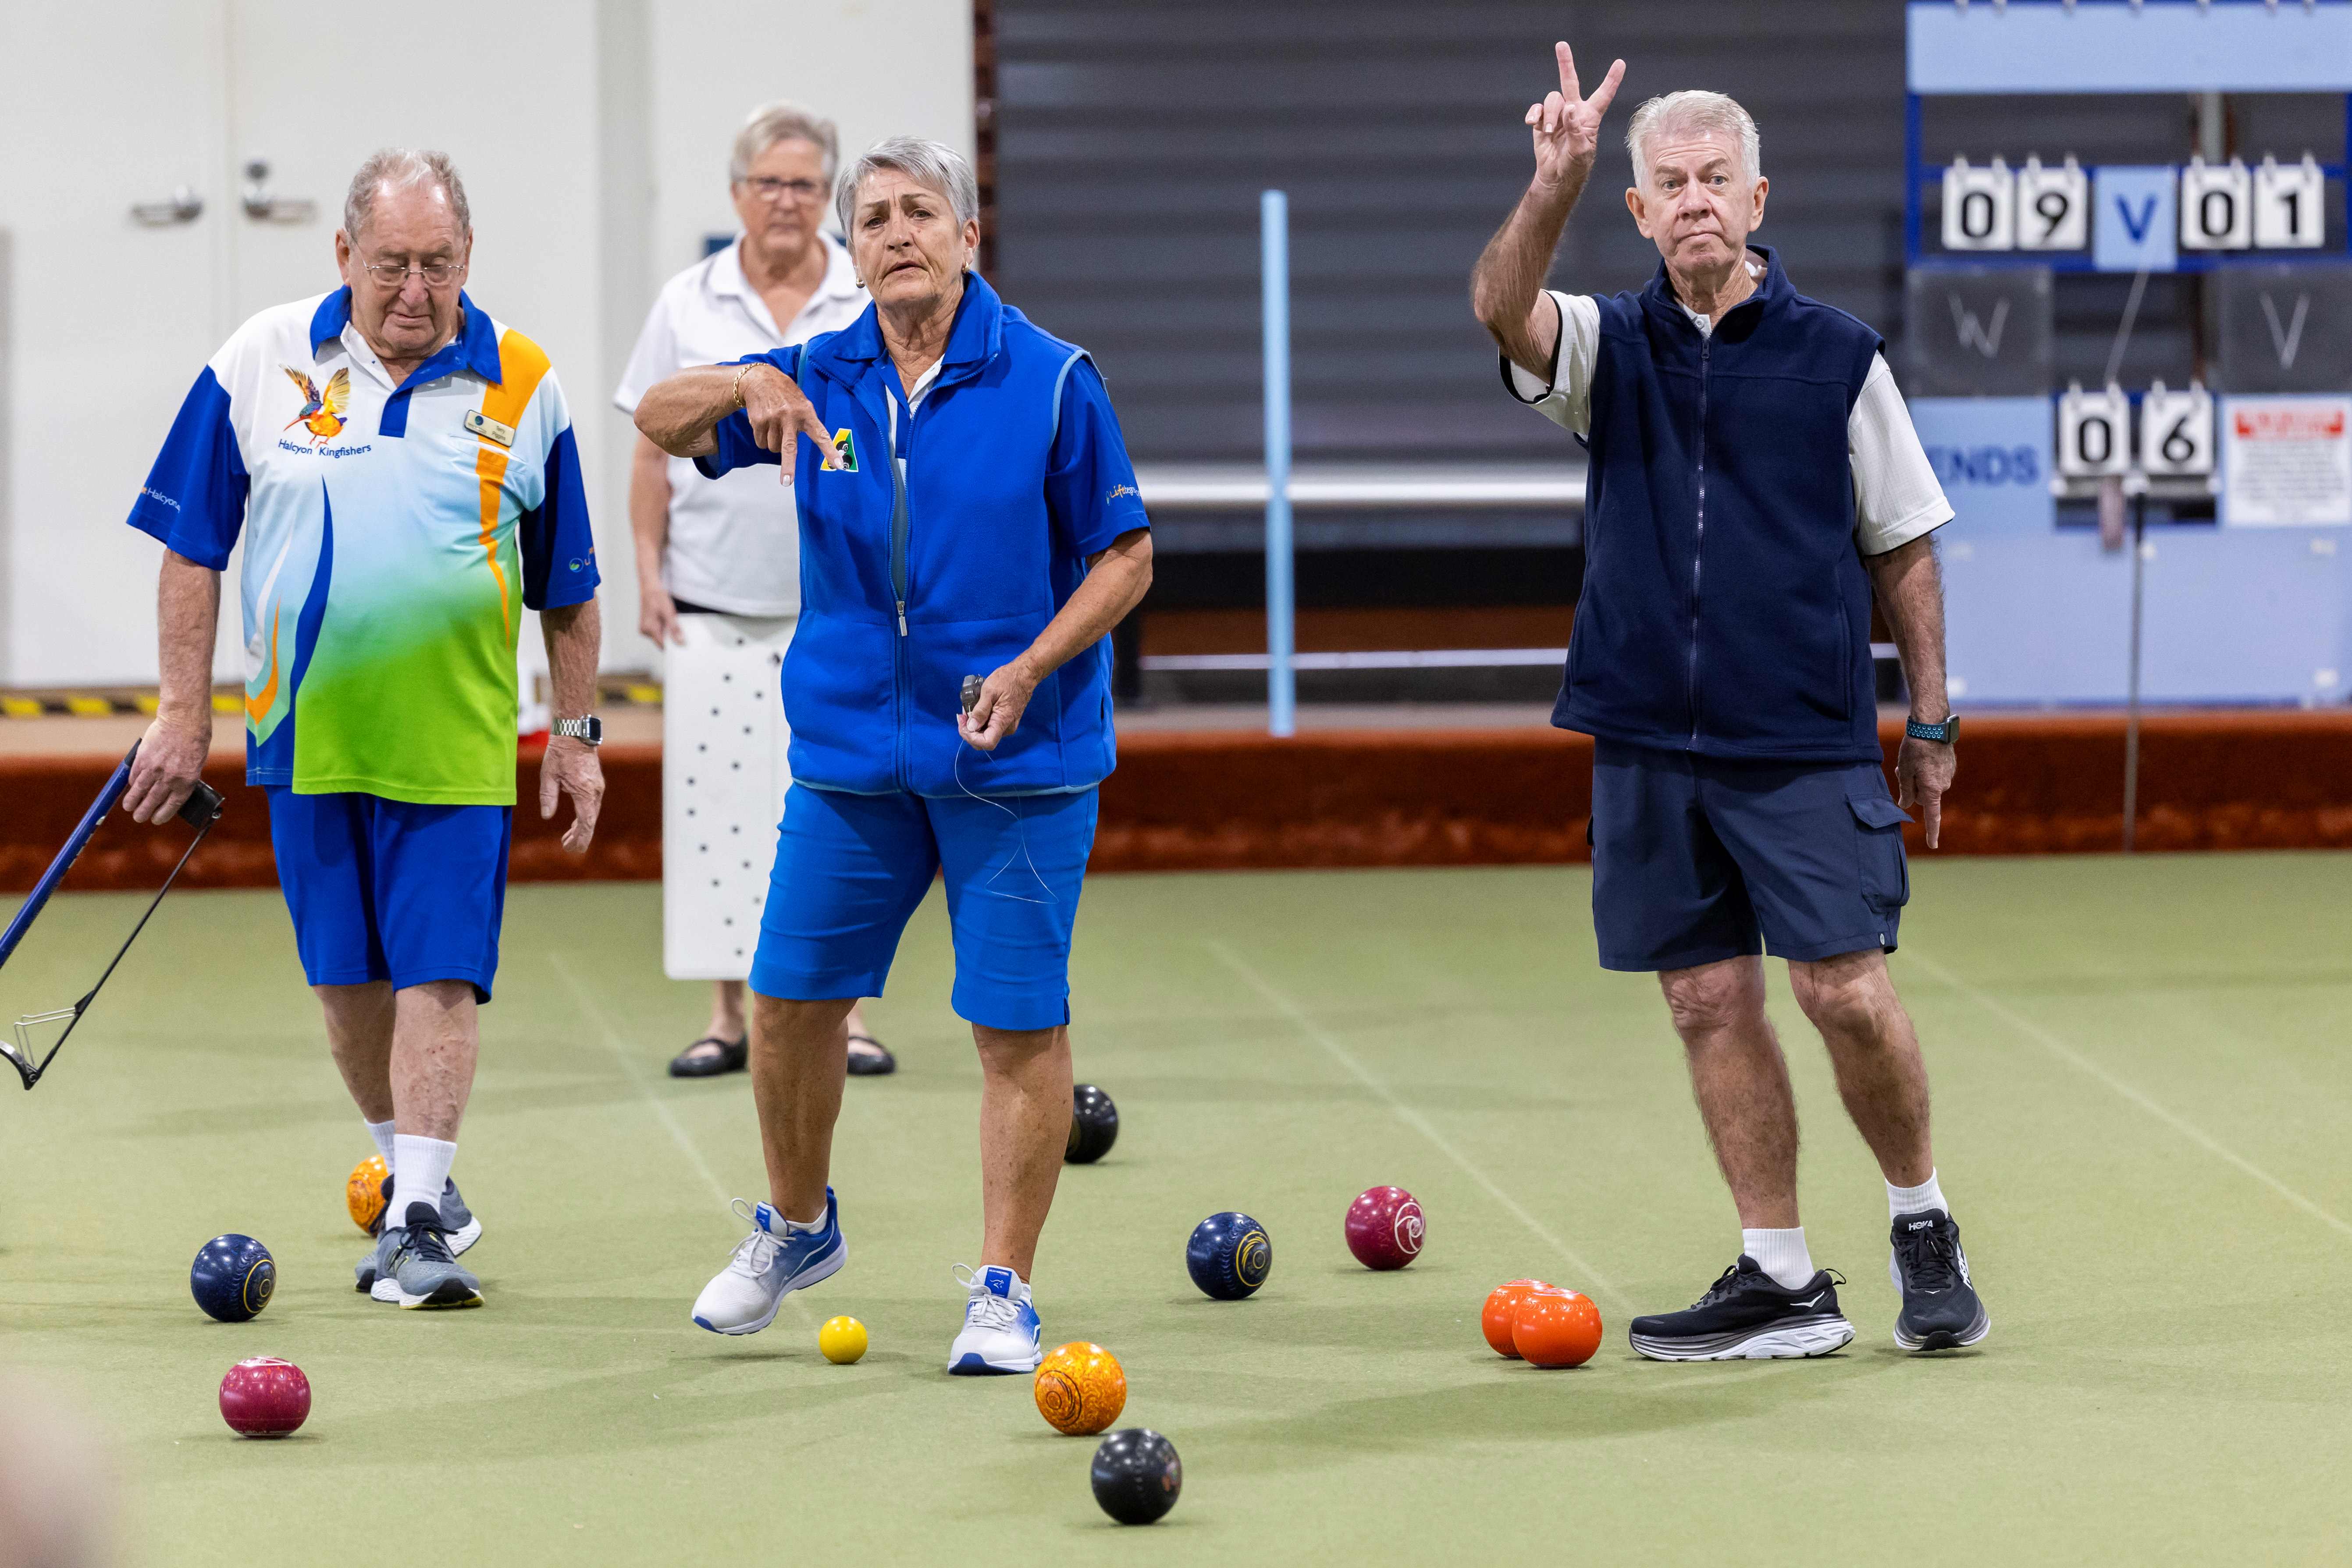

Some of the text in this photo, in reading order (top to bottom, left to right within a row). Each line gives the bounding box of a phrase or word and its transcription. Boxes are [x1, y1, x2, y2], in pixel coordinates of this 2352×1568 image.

[1961, 191, 2299, 244] 09 V 01
[278, 439, 372, 459] Halcyon Kingfishers
[2078, 416, 2195, 463] 06
